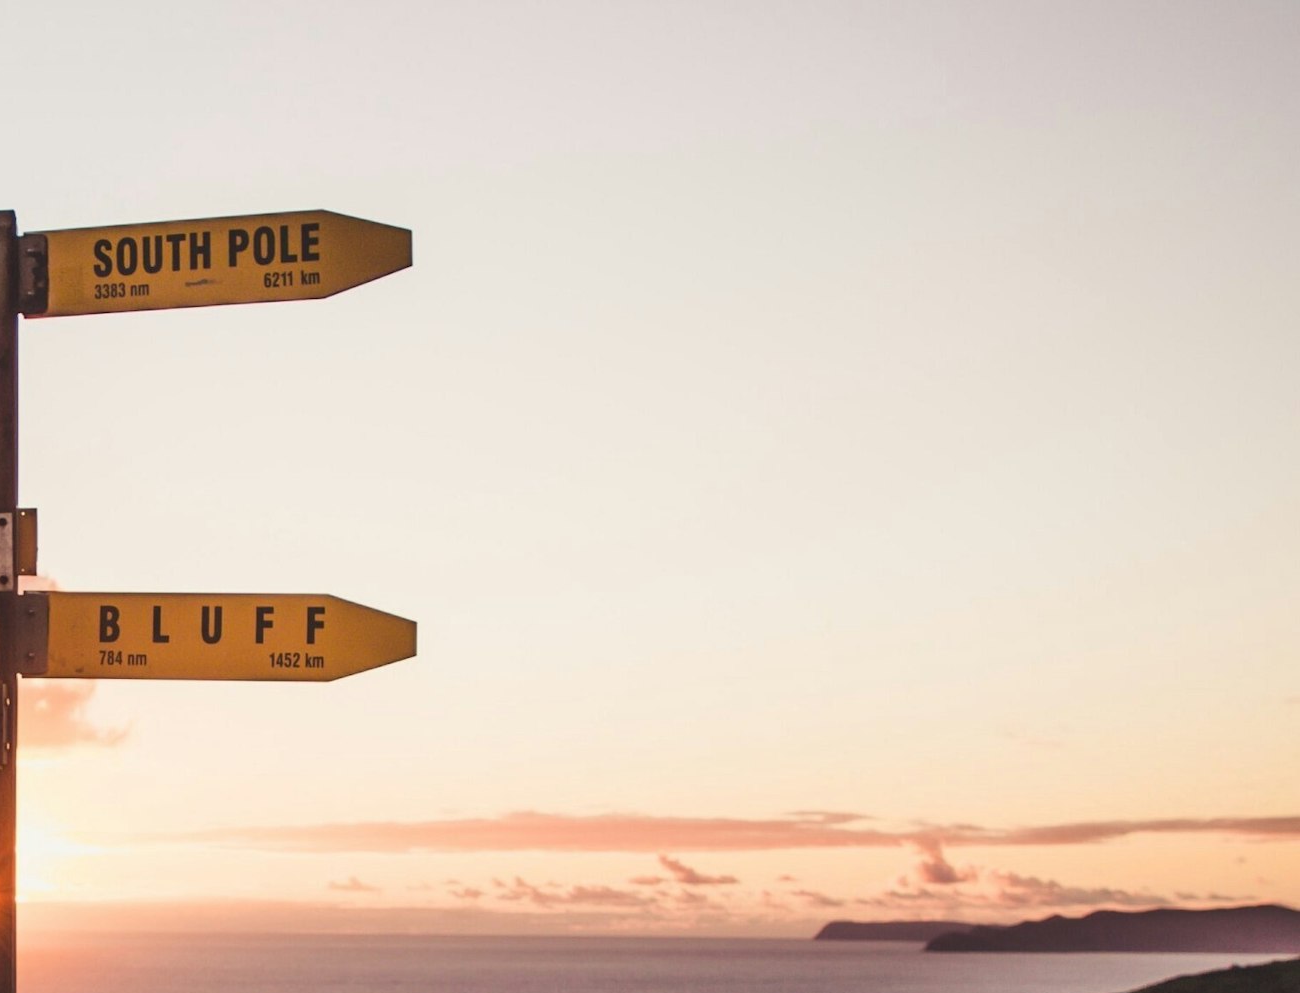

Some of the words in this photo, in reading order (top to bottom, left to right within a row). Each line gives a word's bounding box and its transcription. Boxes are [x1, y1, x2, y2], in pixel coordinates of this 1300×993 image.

[93, 231, 211, 277] SOUTH
[228, 223, 320, 267] POLE
[94, 283, 126, 299] 3383
[130, 282, 149, 297] nm
[264, 271, 293, 288] 6211
[301, 270, 320, 285] km
[99, 605, 325, 644] BLUFF
[99, 651, 123, 666] 784
[127, 651, 147, 666] nm
[269, 652, 300, 668] 1452
[305, 653, 324, 668] km
